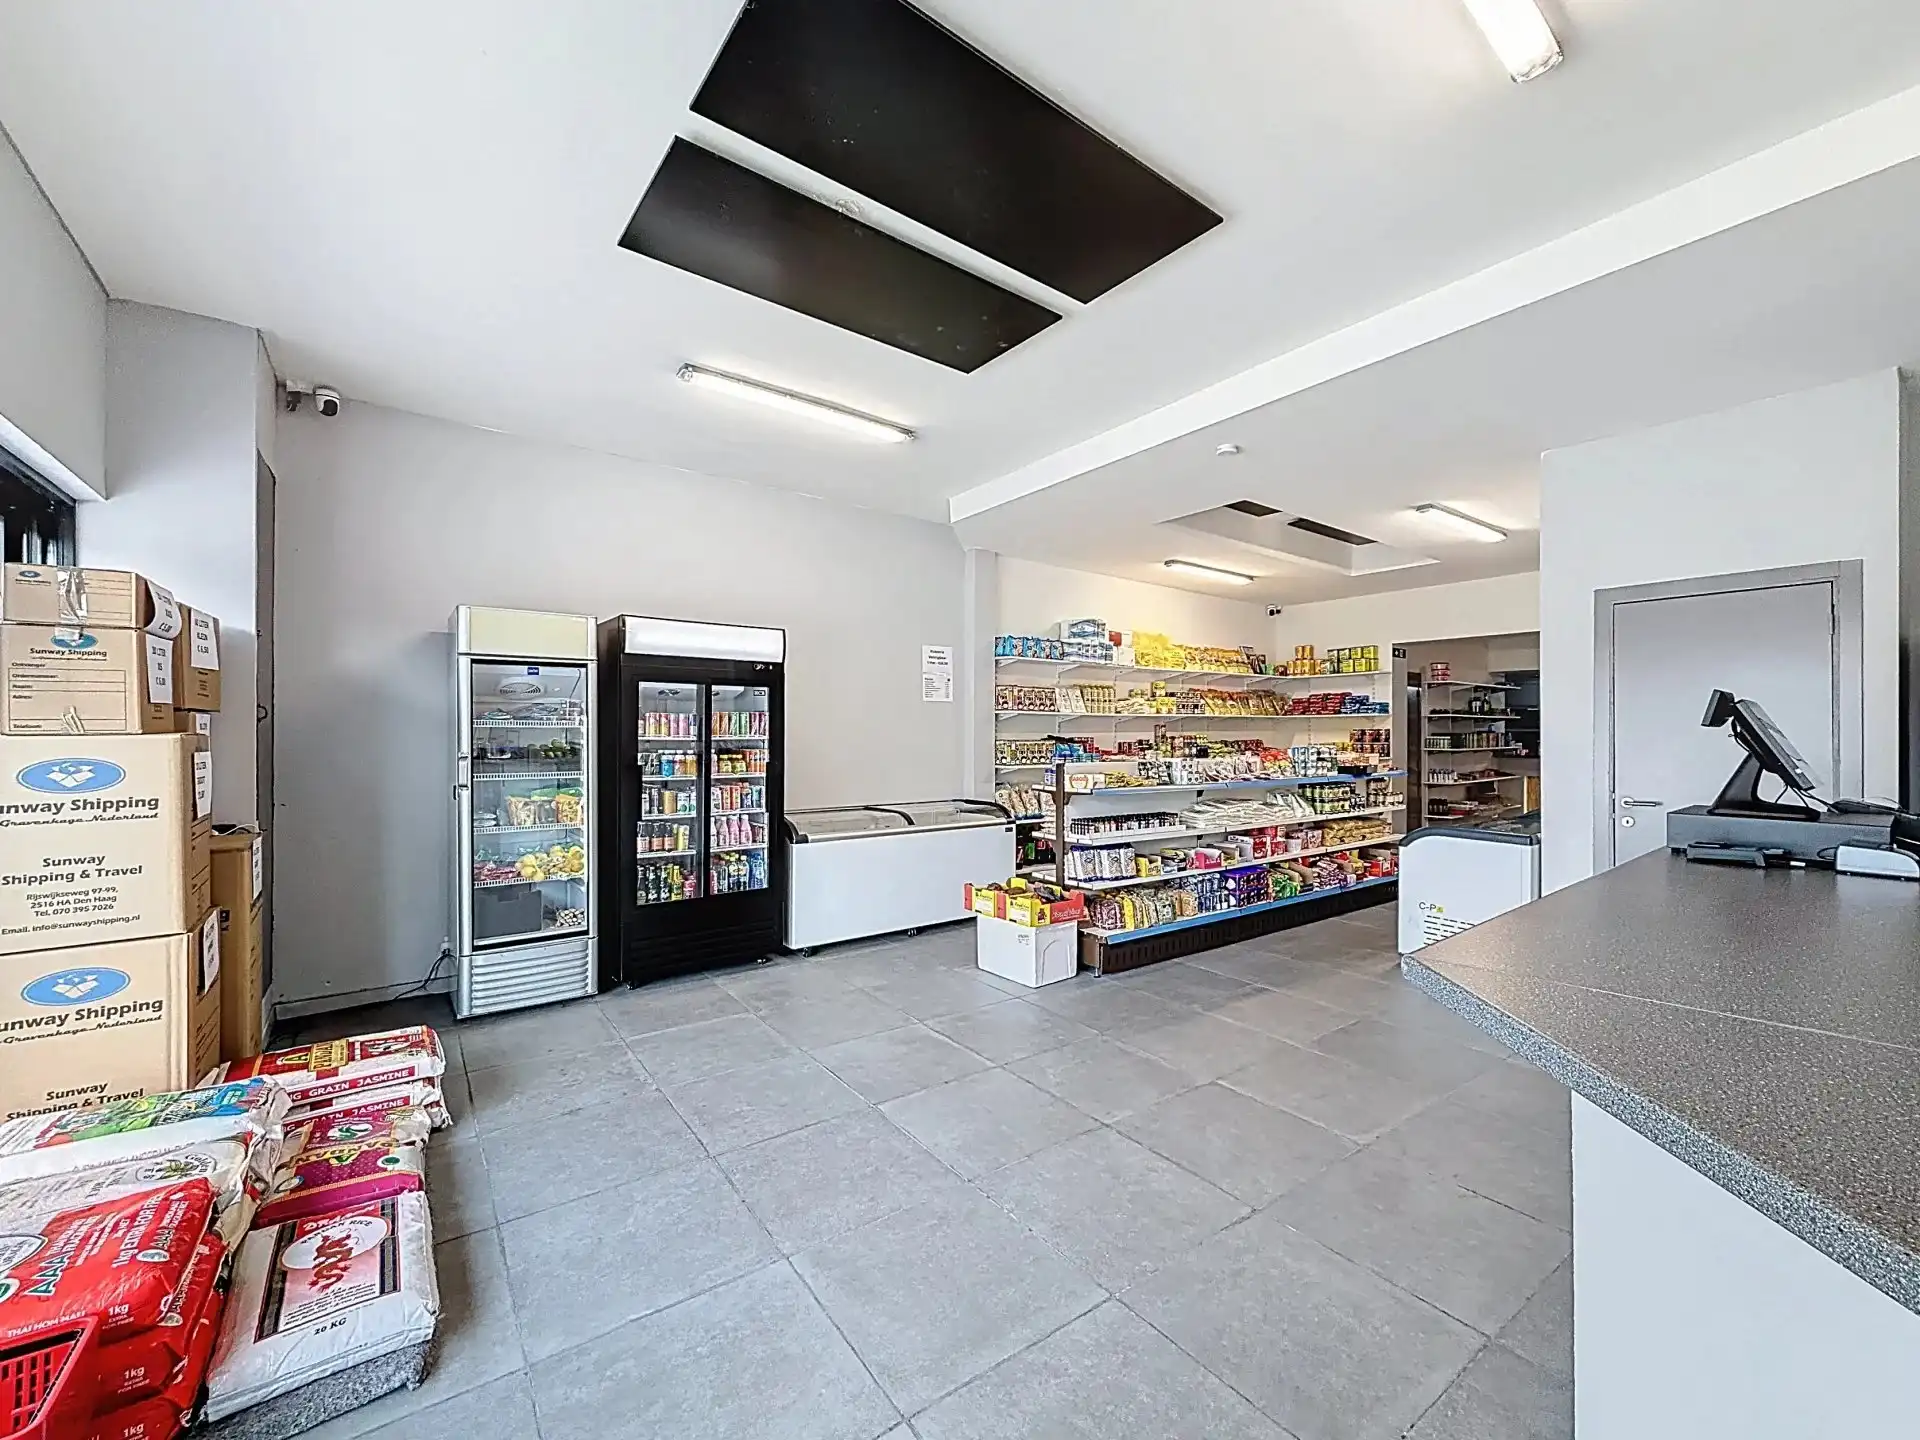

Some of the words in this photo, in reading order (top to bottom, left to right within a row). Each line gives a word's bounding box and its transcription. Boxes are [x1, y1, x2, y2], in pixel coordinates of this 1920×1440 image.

[29, 647, 66, 656] Sunway
[67, 648, 107, 657] Shipping
[70, 796, 159, 812] Shipping
[42, 855, 106, 868] Sunway
[1, 872, 76, 886] Shipping
[79, 869, 91, 879] &
[94, 864, 143, 878] Travel
[30, 901, 55, 909] 2516
[73, 897, 92, 905] Den
[93, 895, 117, 903] Haag
[52, 908, 71, 916] 070
[91, 903, 115, 911] 7026
[74, 999, 164, 1021] Shipping
[309, 1081, 350, 1098] GRAIN
[356, 1068, 410, 1088] JASMINE
[46, 1082, 108, 1101] Sunway
[81, 1098, 93, 1108] &
[96, 1088, 144, 1105] Travel
[351, 1098, 405, 1115] JASMINE
[108, 1303, 129, 1316] 1kg
[7, 1325, 34, 1338] THAI
[36, 1318, 59, 1330] HOM
[313, 1325, 328, 1336] 20
[329, 1317, 347, 1330] KG
[124, 1366, 145, 1379] 1kg
[123, 1423, 145, 1438] 1kg
